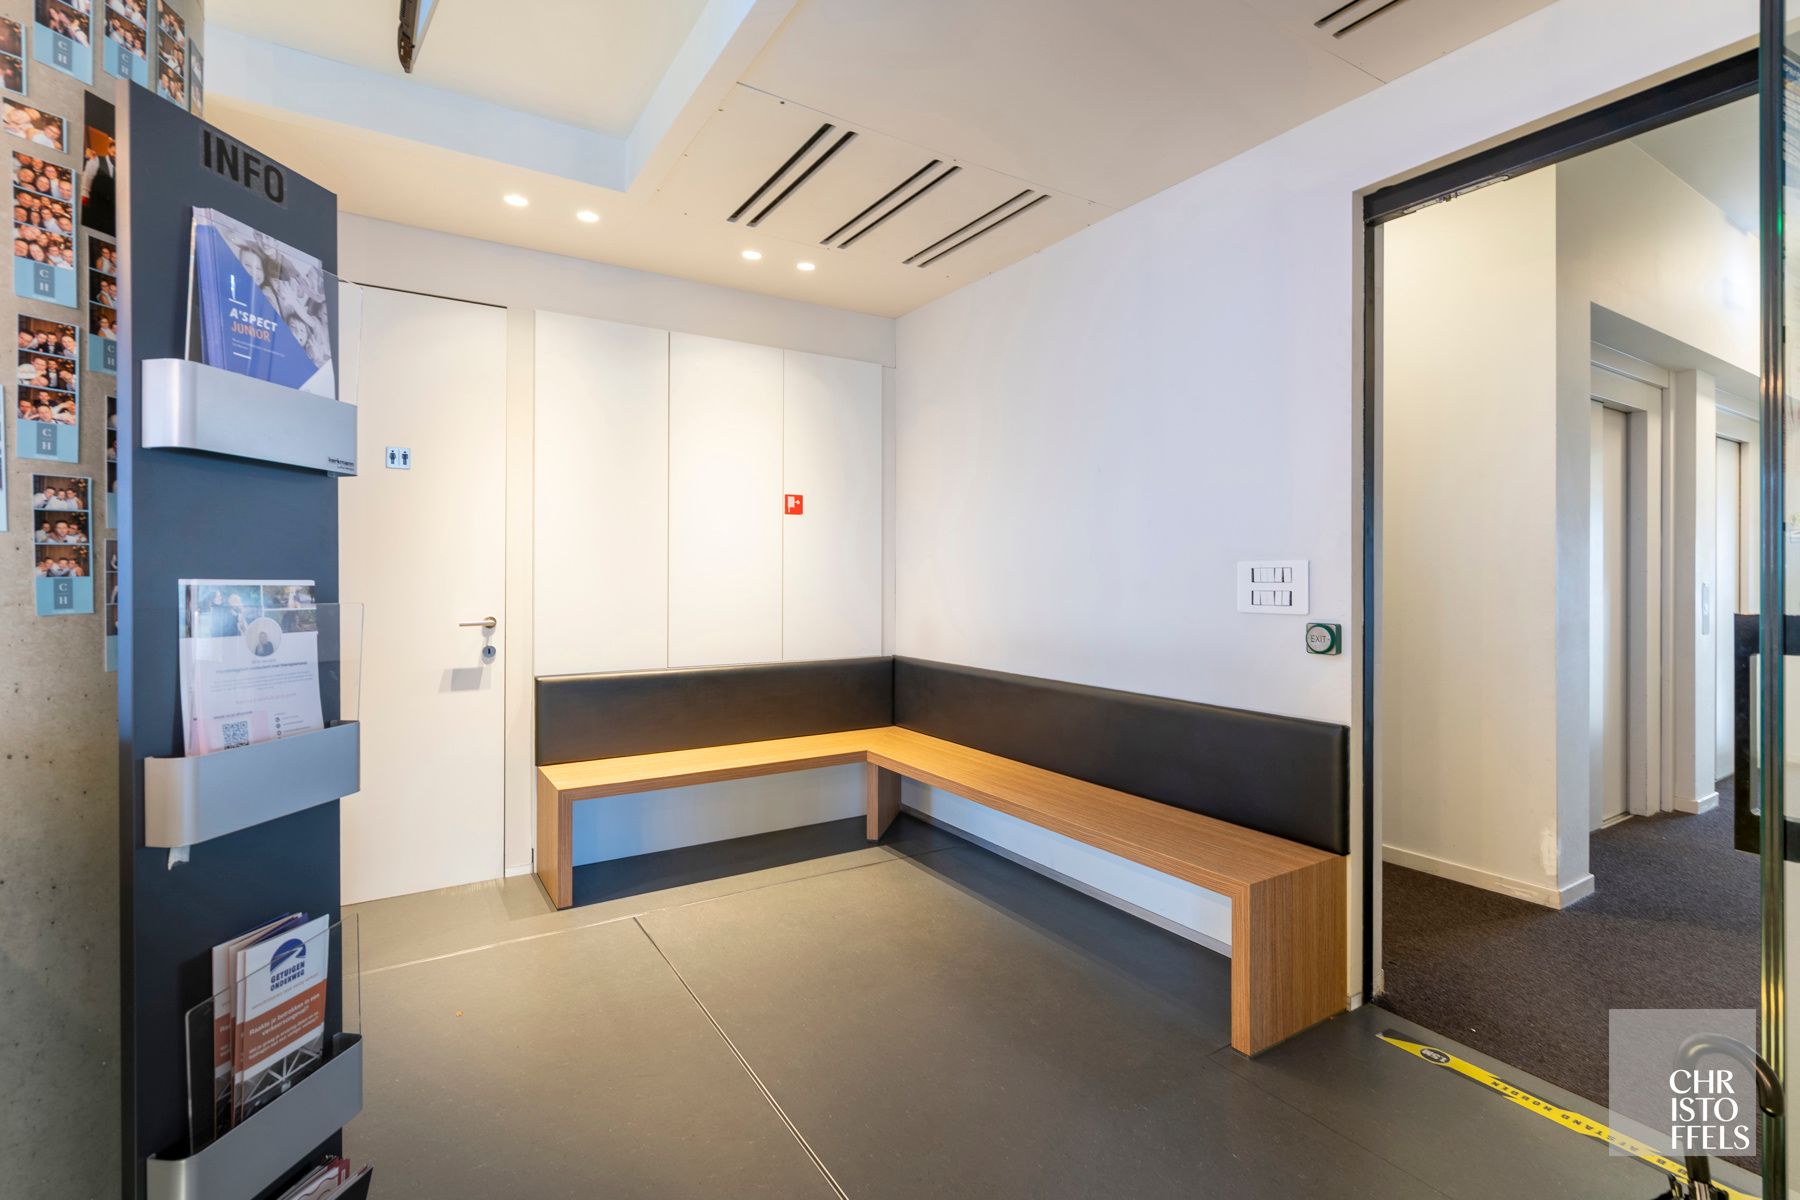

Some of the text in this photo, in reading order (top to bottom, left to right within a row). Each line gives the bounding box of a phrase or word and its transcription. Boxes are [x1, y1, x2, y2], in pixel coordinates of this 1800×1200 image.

[203, 129, 284, 203] INFO
[230, 307, 278, 332] A'SPECT
[231, 321, 271, 343] JUNIOR
[1310, 635, 1326, 643] EXIT
[270, 960, 305, 984] GETUIGEN
[270, 969, 305, 992] ONDERWEG
[1491, 1080, 1553, 1112] HOUDEN
